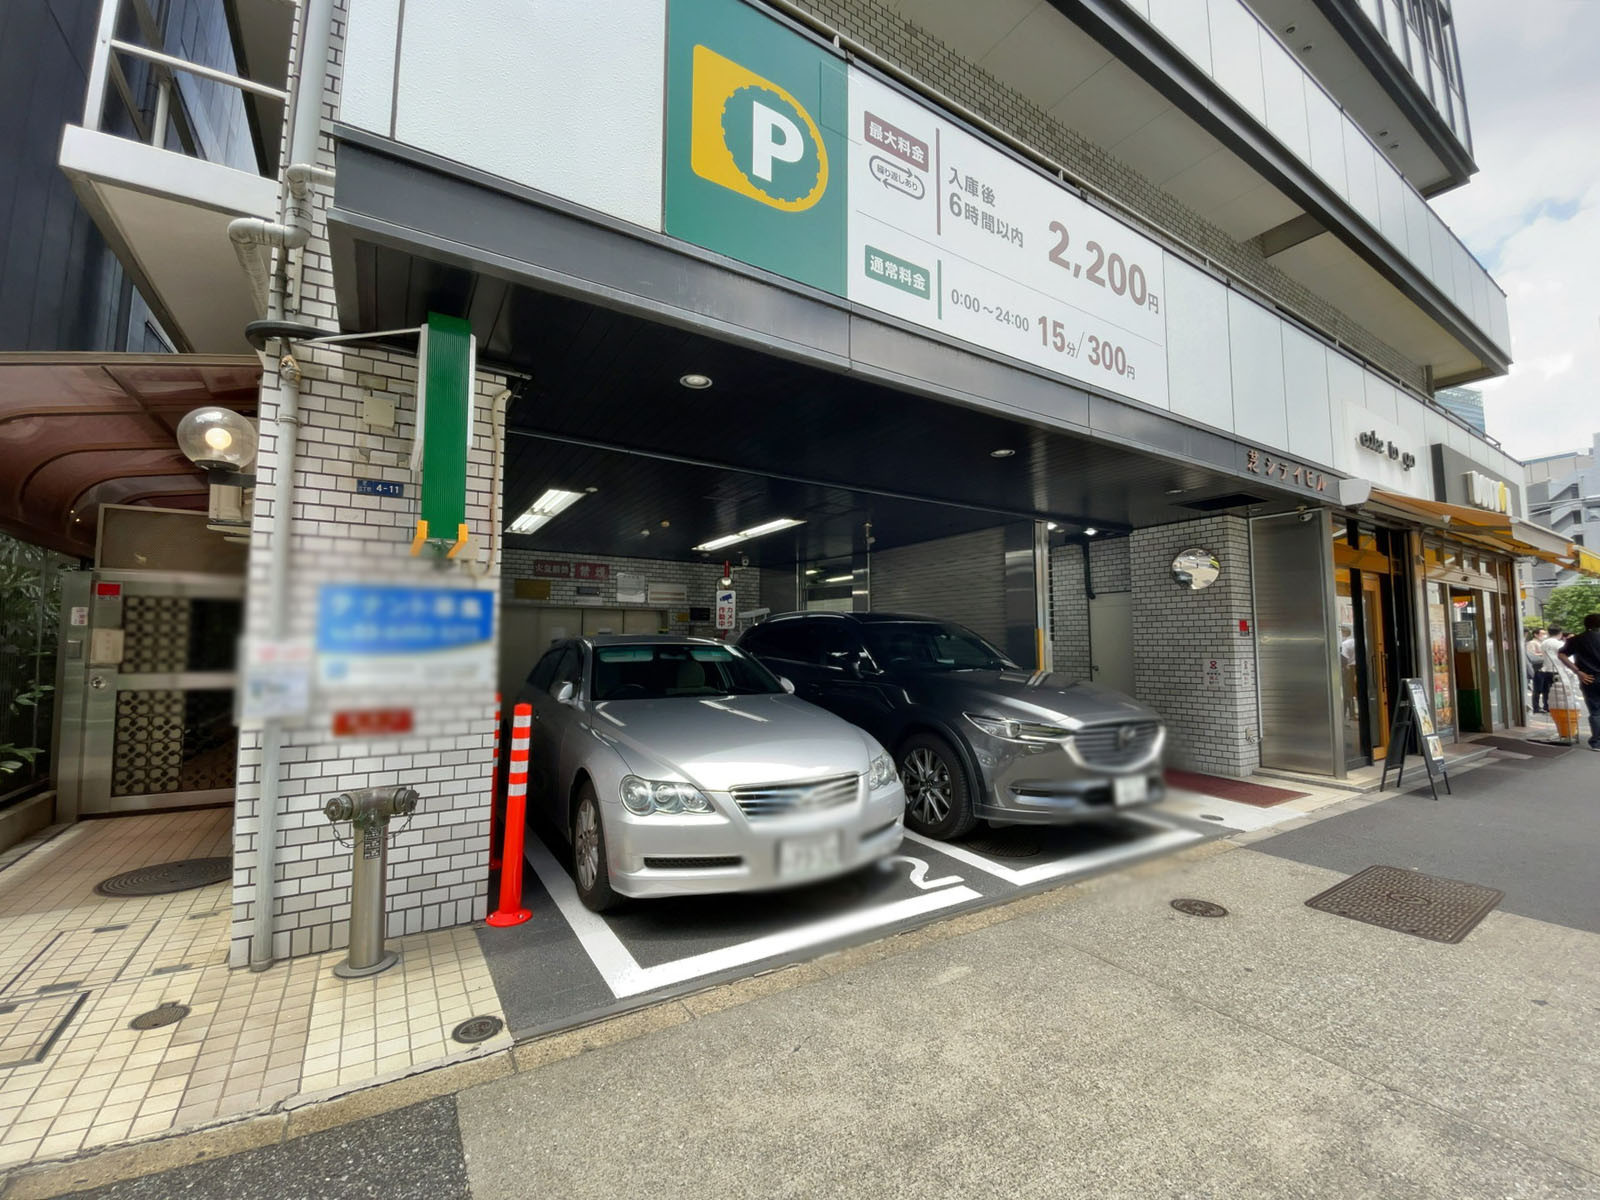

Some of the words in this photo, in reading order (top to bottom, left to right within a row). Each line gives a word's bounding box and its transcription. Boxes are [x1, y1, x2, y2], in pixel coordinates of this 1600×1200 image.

[753, 100, 804, 182] P
[869, 121, 924, 163] 最大料金
[876, 163, 918, 191] 繰り返しあり
[949, 167, 995, 207] 入庫後
[949, 193, 1023, 248] 6時間以内
[870, 255, 925, 291] 通常料金
[1049, 221, 1159, 314] 2,200円
[376, 484, 399, 494] 4-11
[878, 855, 965, 890] 2
